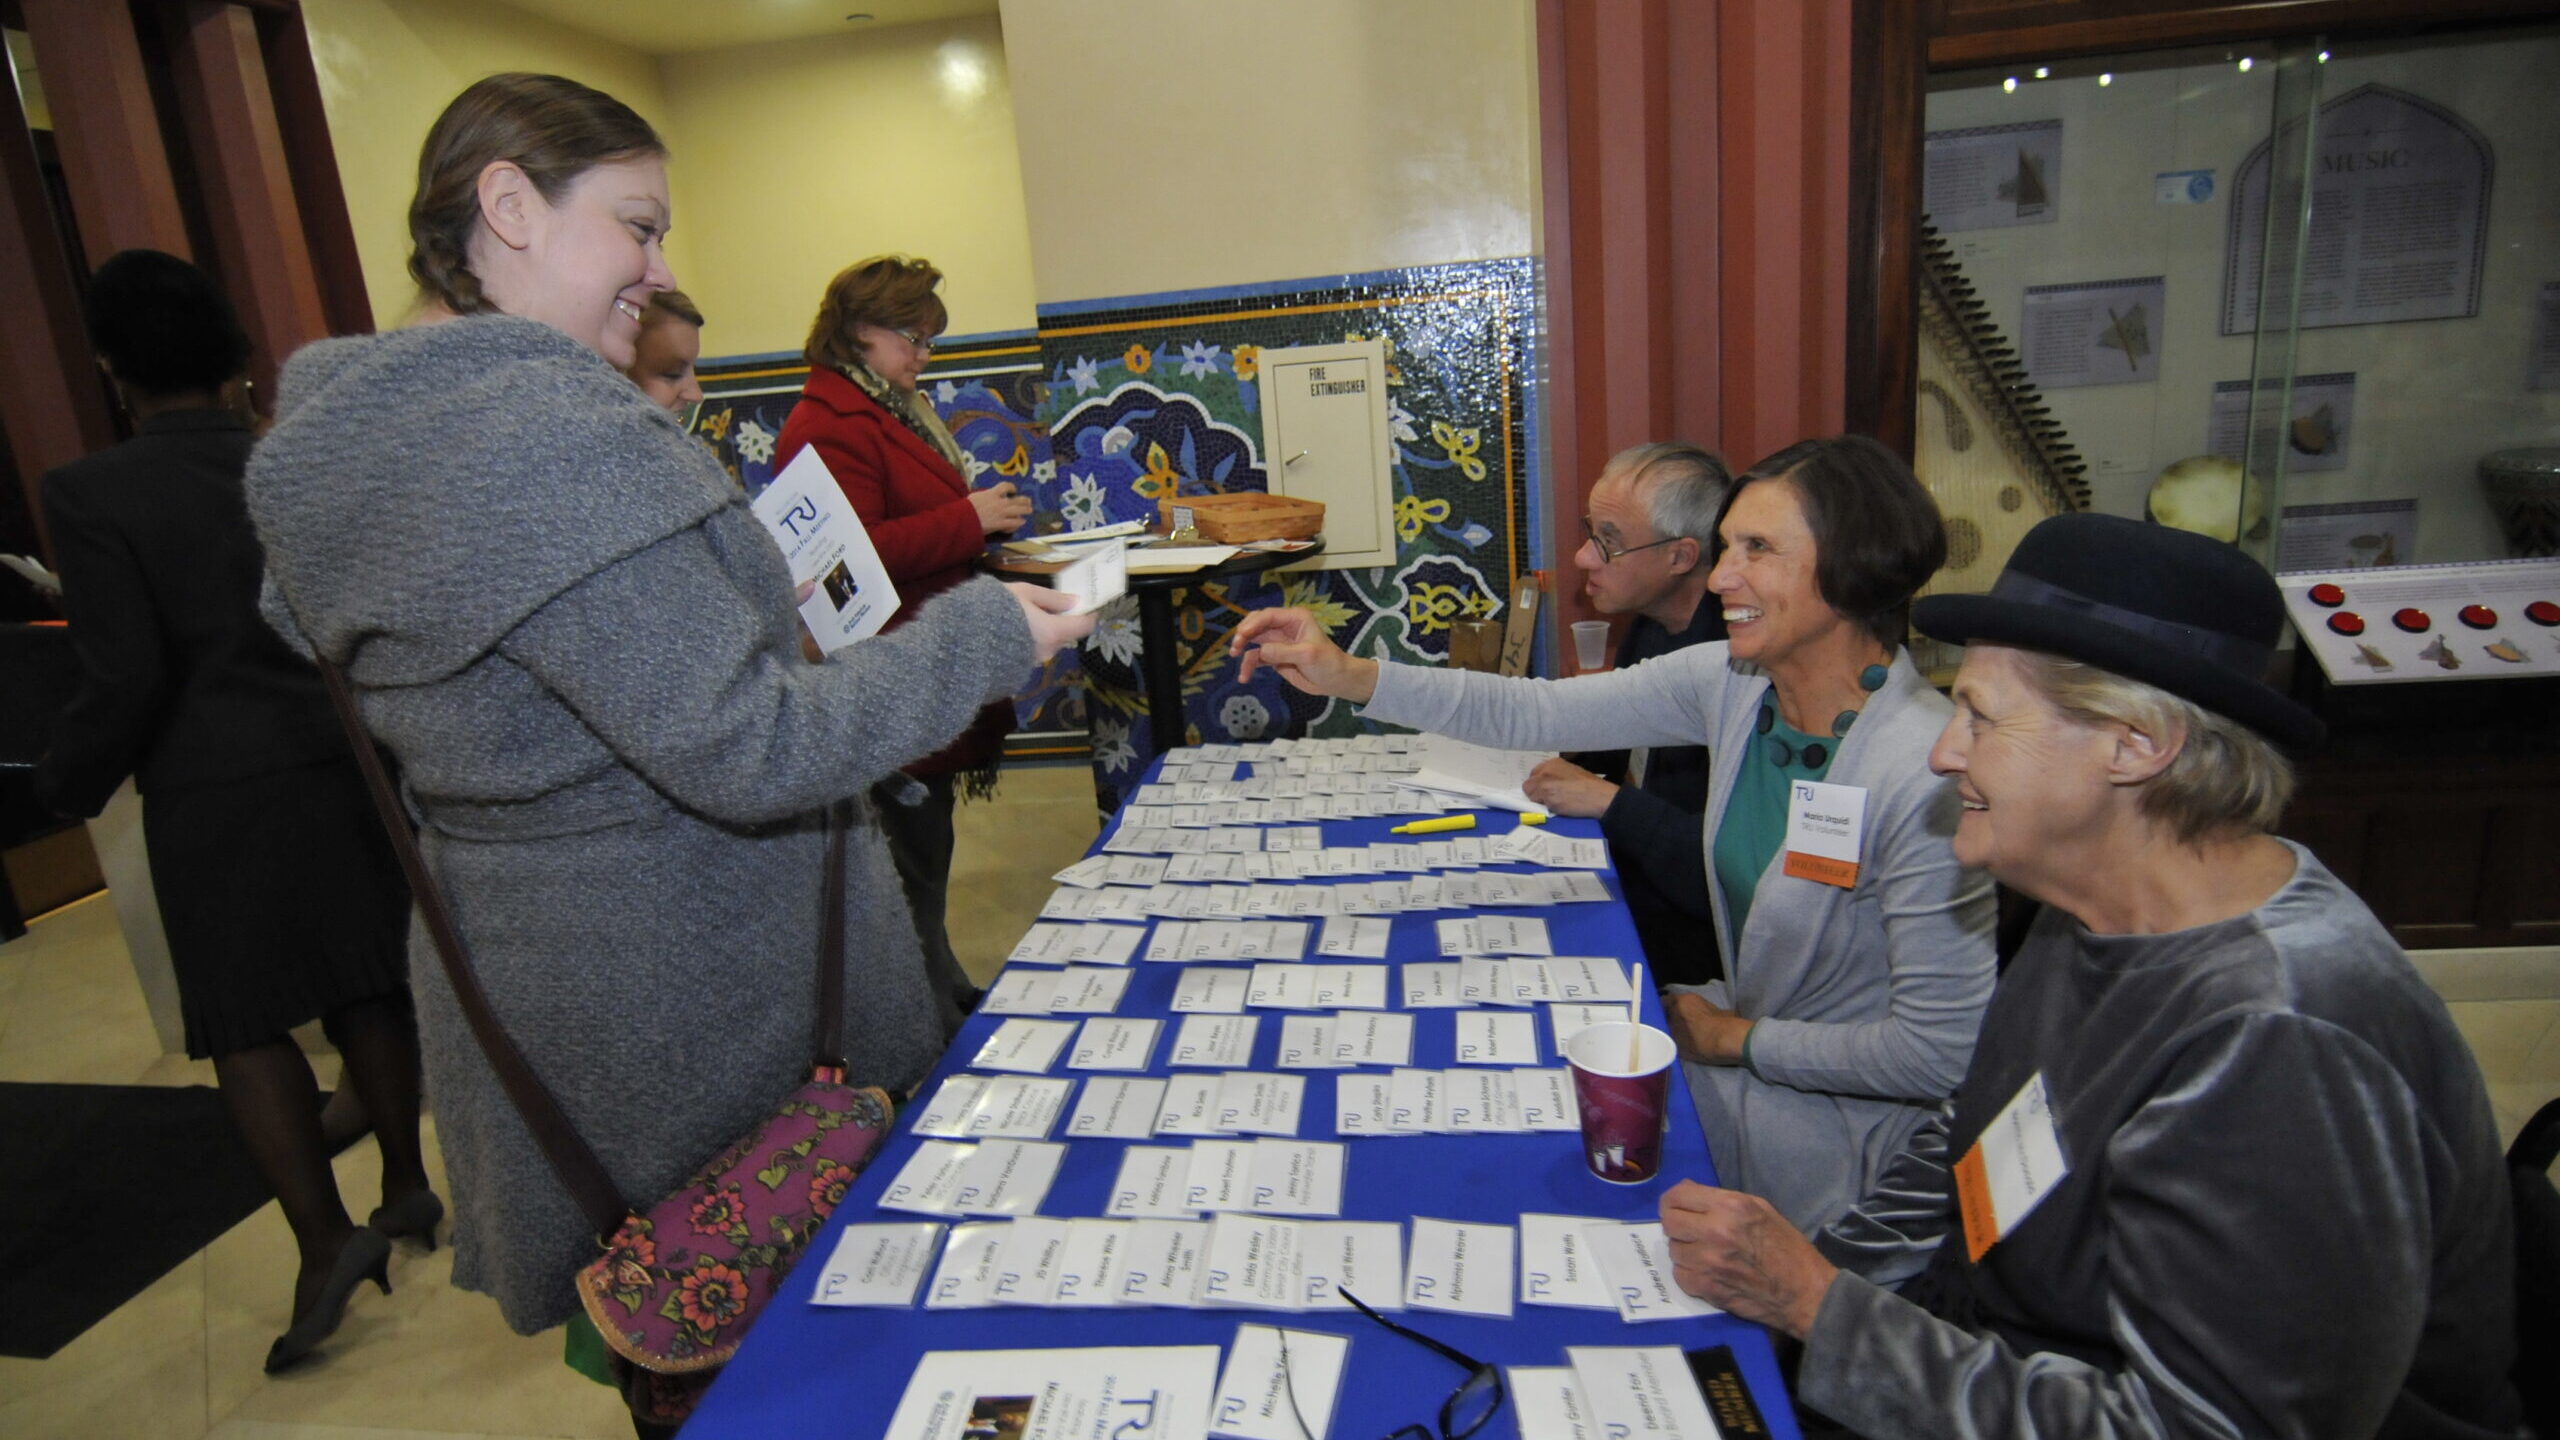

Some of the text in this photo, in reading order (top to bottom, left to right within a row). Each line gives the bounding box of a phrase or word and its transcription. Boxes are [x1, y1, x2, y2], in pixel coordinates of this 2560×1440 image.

[2321, 151, 2409, 175] MUSIC
[1309, 367, 1326, 380] FIRE
[1310, 380, 1365, 397] EXTINGUISHER
[781, 496, 817, 537] TRU
[812, 559, 833, 583] MICHAEL
[831, 543, 847, 562] FORD
[1179, 1248, 1194, 1273] Smith
[1242, 1230, 1265, 1288] Linda Wesley
[1451, 1228, 1468, 1261] Weaver
[1564, 1256, 1579, 1284] Susan
[1628, 1232, 1673, 1304] Andrea Wallace
[1035, 1381, 1061, 1425] MICHAEL
[1259, 1372, 1286, 1420] Michelle
[1633, 1393, 1662, 1431] Deena
[1652, 1397, 1681, 1432] Board
